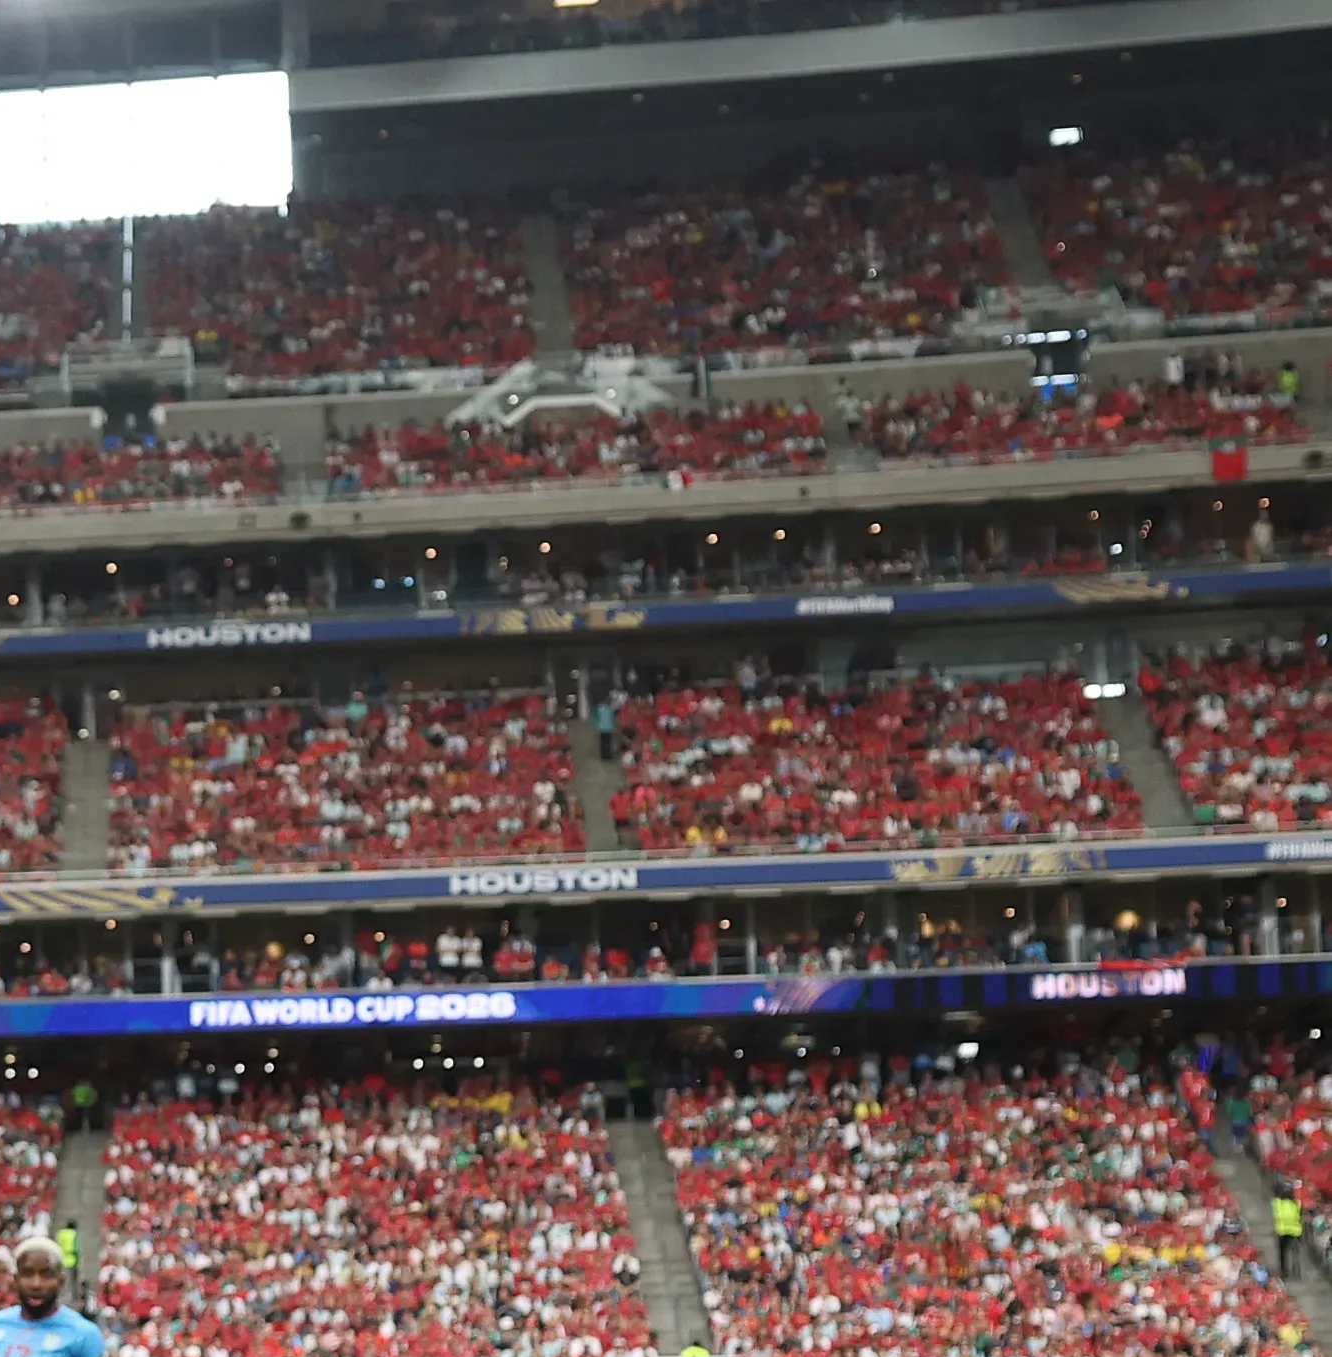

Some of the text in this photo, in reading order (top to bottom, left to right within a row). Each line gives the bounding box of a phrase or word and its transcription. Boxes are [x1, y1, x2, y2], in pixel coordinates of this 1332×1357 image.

[147, 622, 311, 649] HOUSTON
[448, 867, 638, 896] HOUSTON
[1031, 968, 1187, 1000] HOUSTON
[189, 992, 517, 1027] FIFA WORLD CUP 2026
